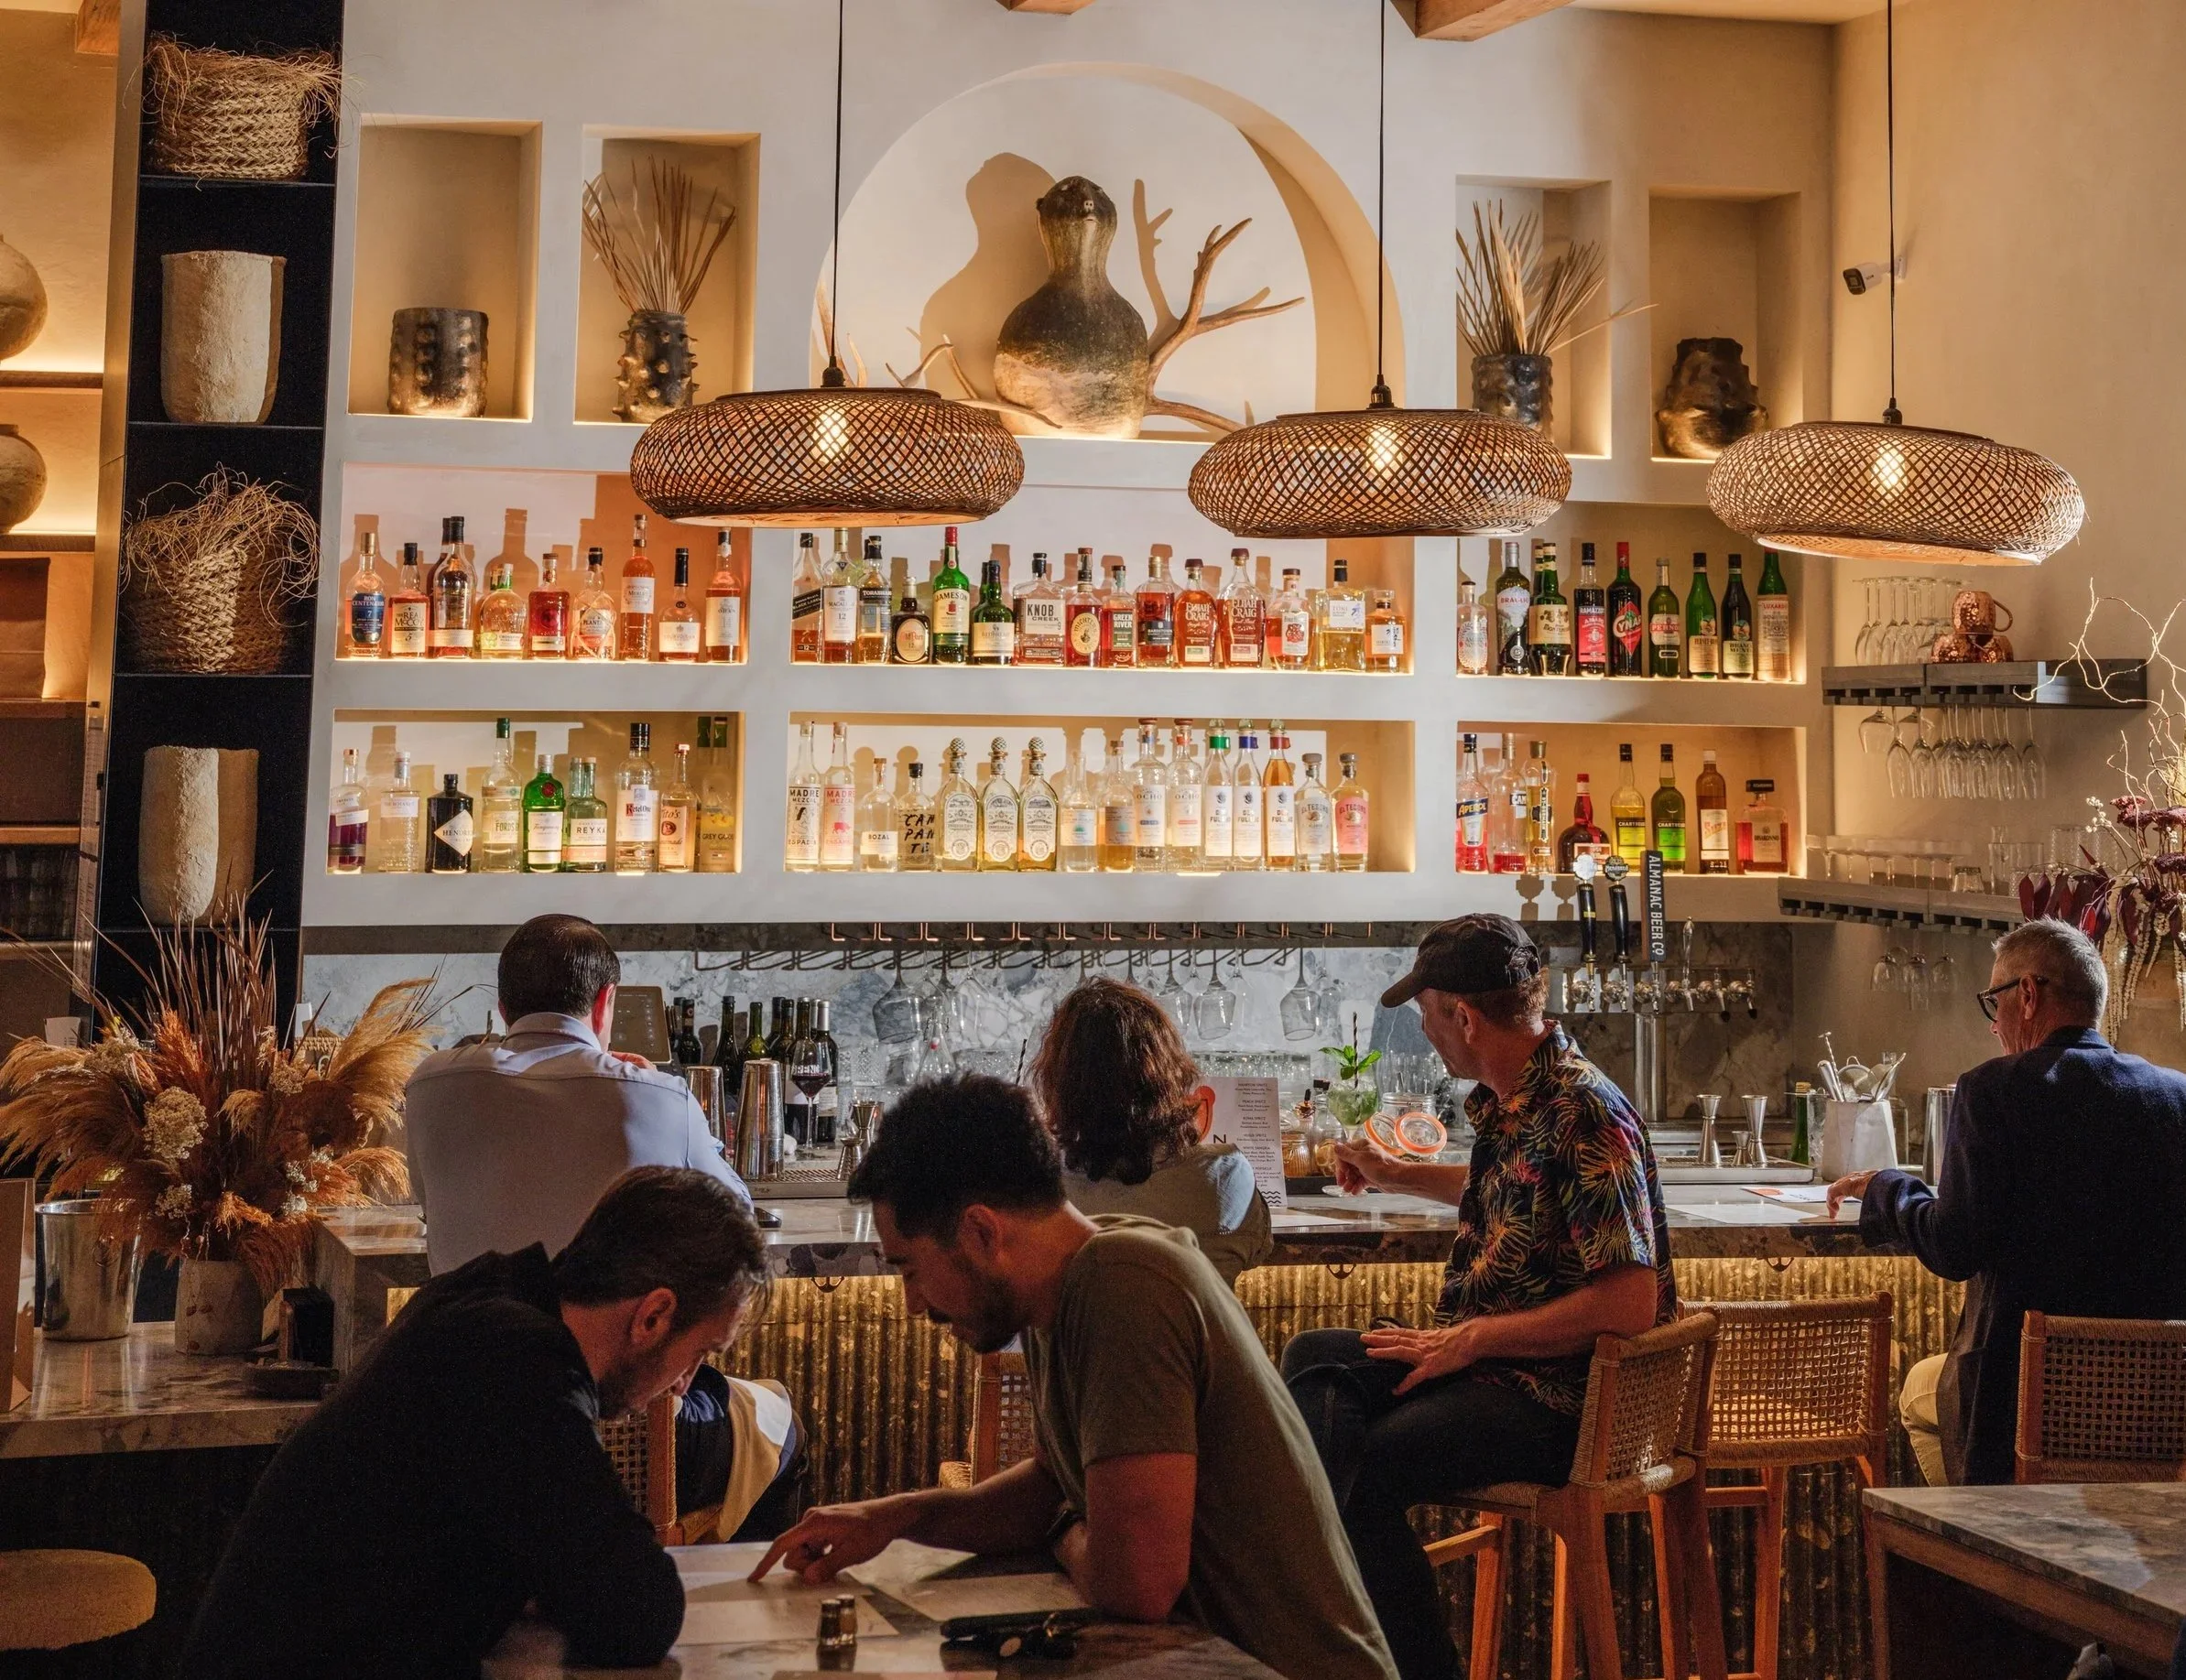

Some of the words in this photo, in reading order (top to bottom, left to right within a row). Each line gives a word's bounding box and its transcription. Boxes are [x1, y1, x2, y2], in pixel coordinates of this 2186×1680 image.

[935, 591, 967, 602] JAMESON
[1027, 604, 1054, 616] KNOB
[1232, 608, 1257, 618] CRAIG
[1185, 611, 1209, 621] CRAIG
[406, 633, 412, 641] 5
[789, 789, 819, 797] MADRE
[626, 803, 642, 816] Ketel
[643, 805, 651, 813] One
[1458, 802, 1486, 816] APEROL
[495, 822, 515, 832] FORDS
[904, 829, 935, 840] PAN
[1648, 855, 1662, 909] ALMANAC
[1650, 911, 1663, 939] BEER
